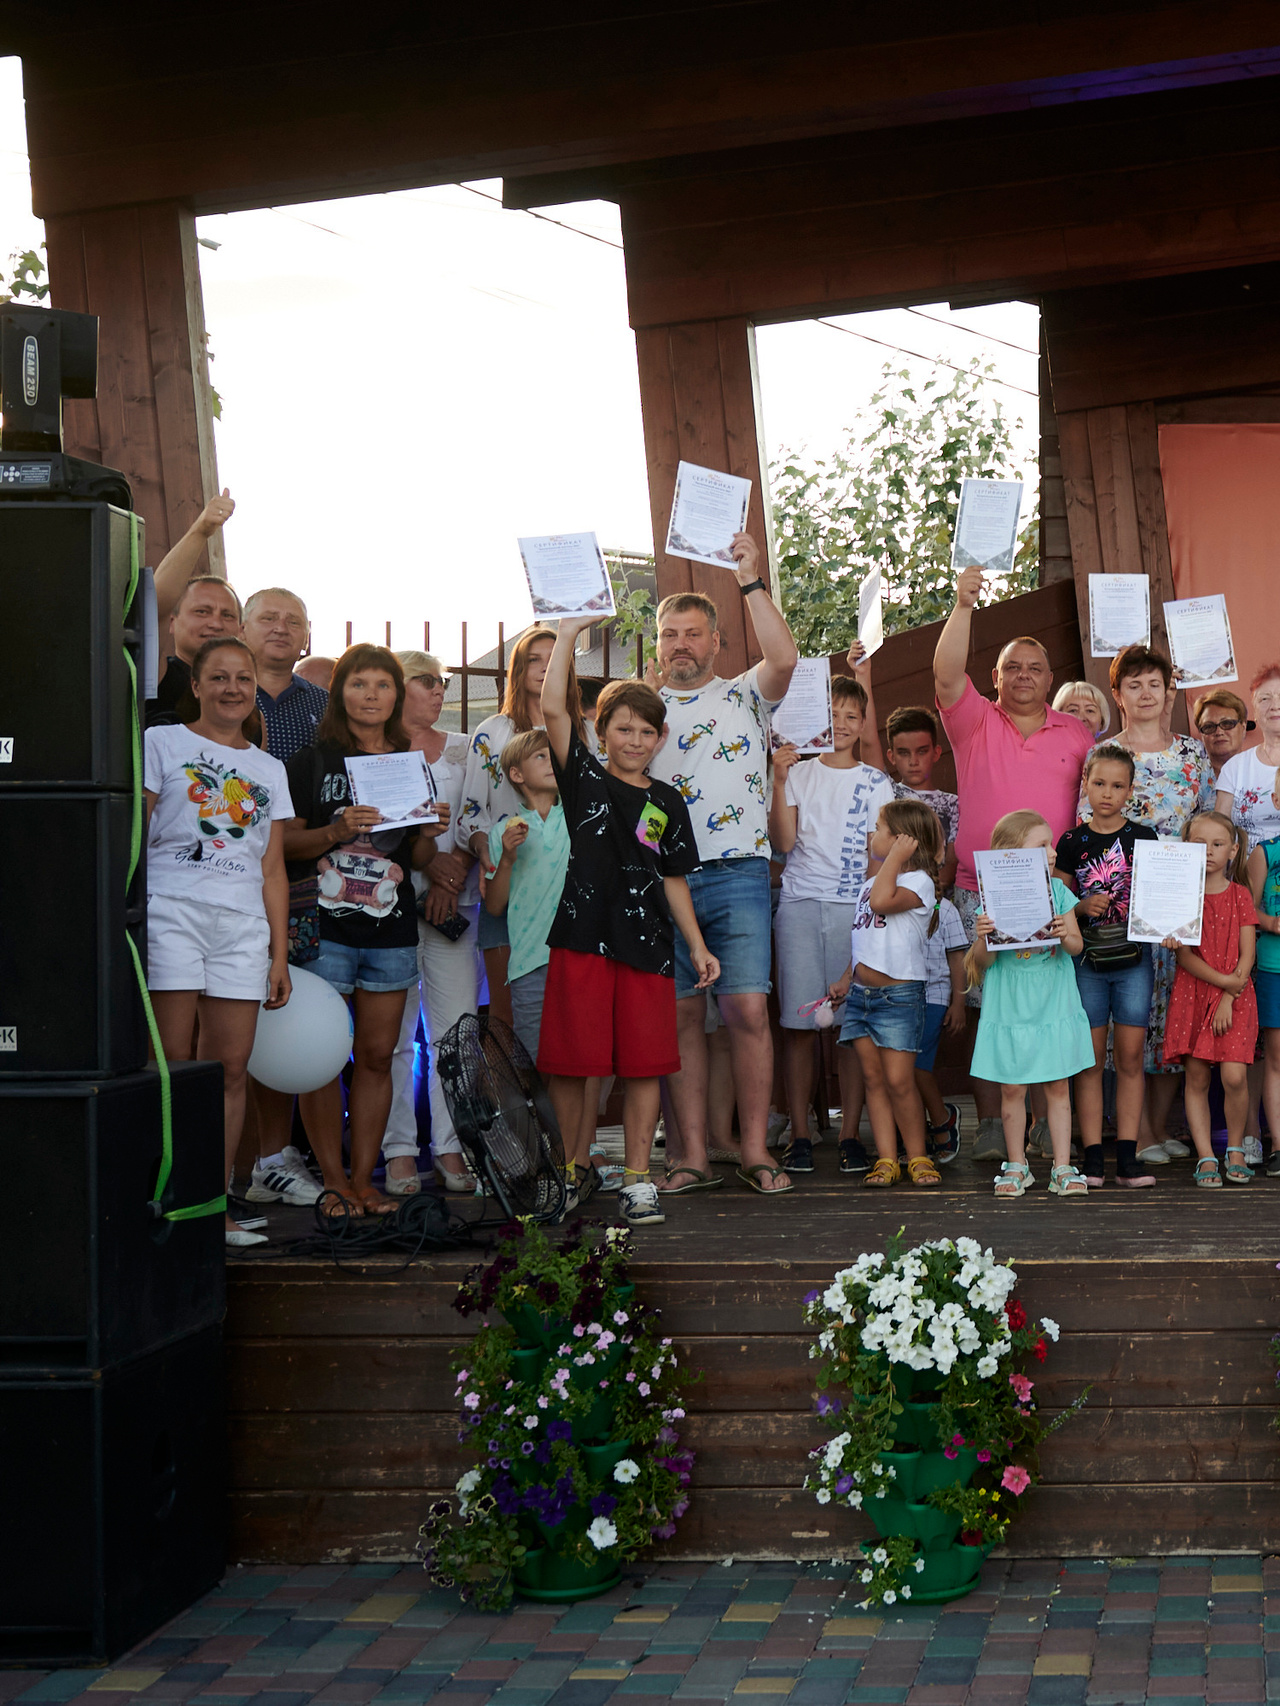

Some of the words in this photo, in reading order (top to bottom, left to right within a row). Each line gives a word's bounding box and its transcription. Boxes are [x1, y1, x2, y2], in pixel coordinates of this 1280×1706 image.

[26, 344, 35, 376] BEAM
[26, 377, 35, 398] 230
[990, 858, 1033, 866] СЕРТИФИКАТ
